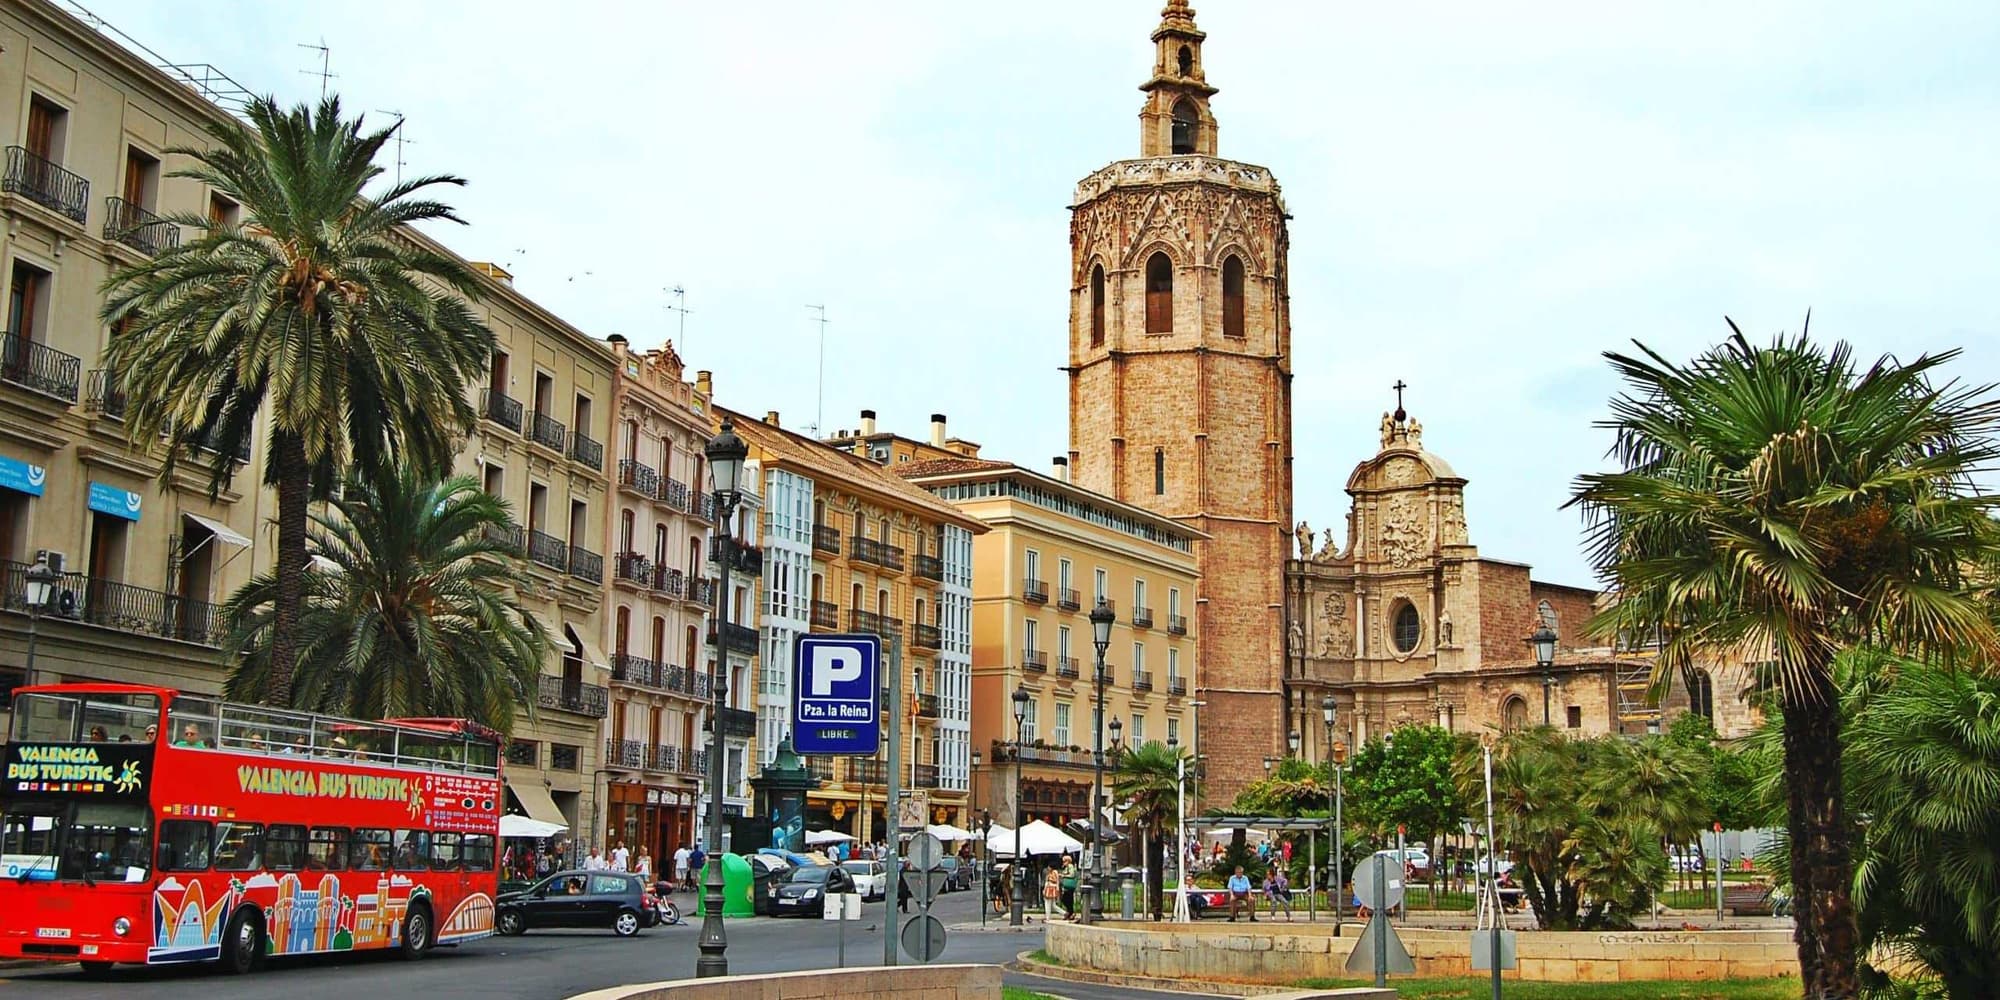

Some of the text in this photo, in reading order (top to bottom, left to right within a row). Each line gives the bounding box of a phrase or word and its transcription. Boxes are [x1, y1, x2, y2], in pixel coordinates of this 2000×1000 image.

[812, 646, 862, 695] P
[804, 703, 868, 717] Pza. la Reina
[822, 730, 849, 738] LIBRE
[19, 747, 99, 763] VALENCIA
[7, 763, 114, 782] BUS TURISTIC
[237, 765, 316, 797] VALENCIA
[319, 772, 347, 798] BUS
[348, 774, 407, 802] TURISTIC
